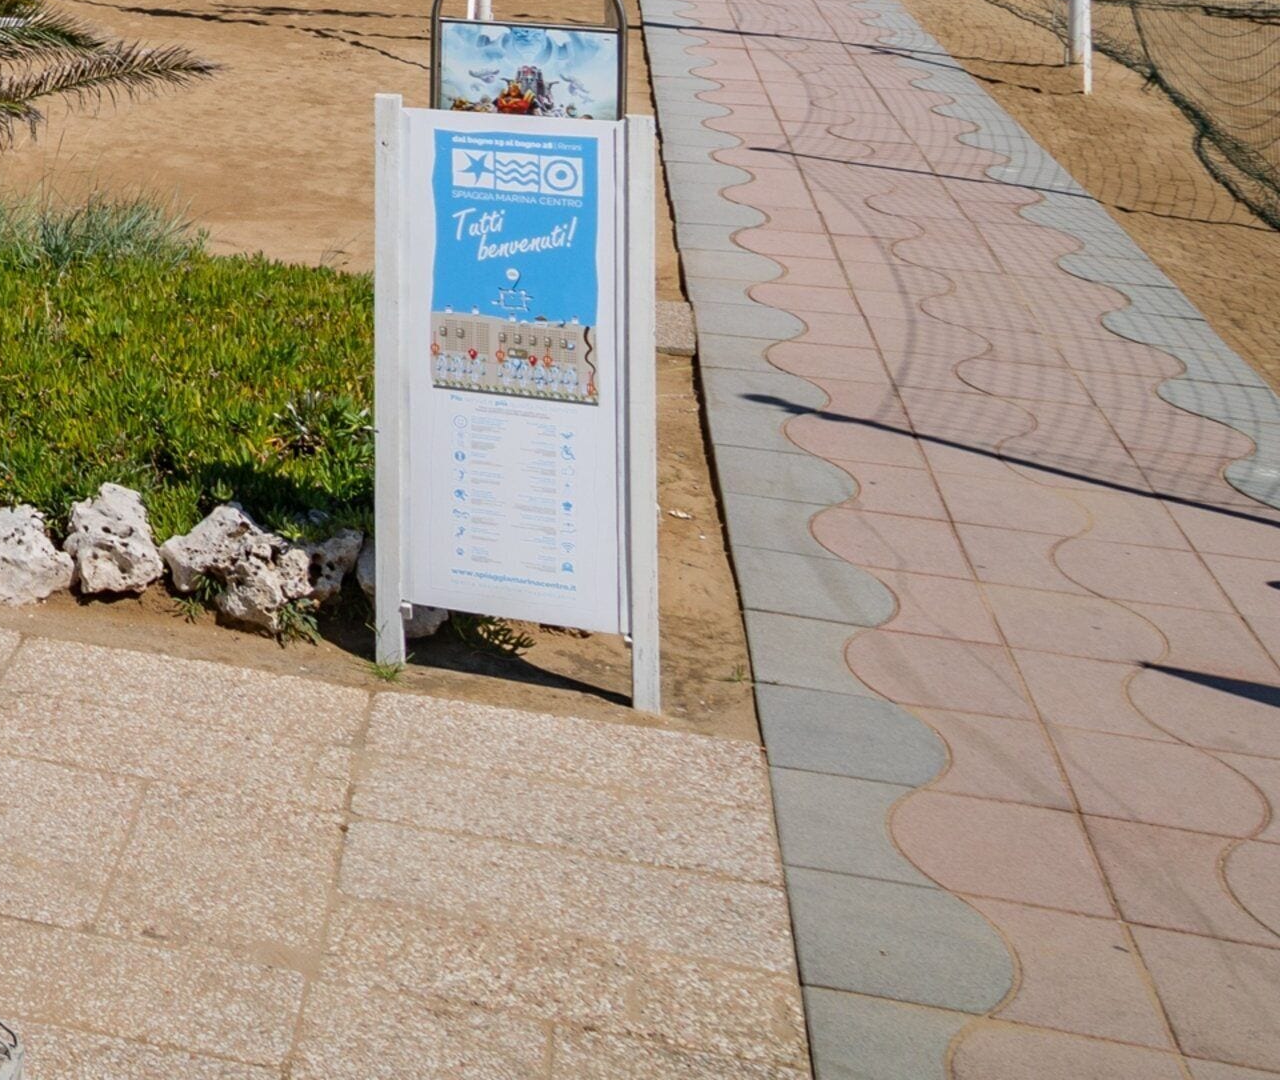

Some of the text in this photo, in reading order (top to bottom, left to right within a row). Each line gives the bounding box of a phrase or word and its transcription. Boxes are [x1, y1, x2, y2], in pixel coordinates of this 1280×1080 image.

[452, 190, 583, 208] SPIAGGIA MARINA CENTRO
[477, 216, 578, 261] benvenuti!
